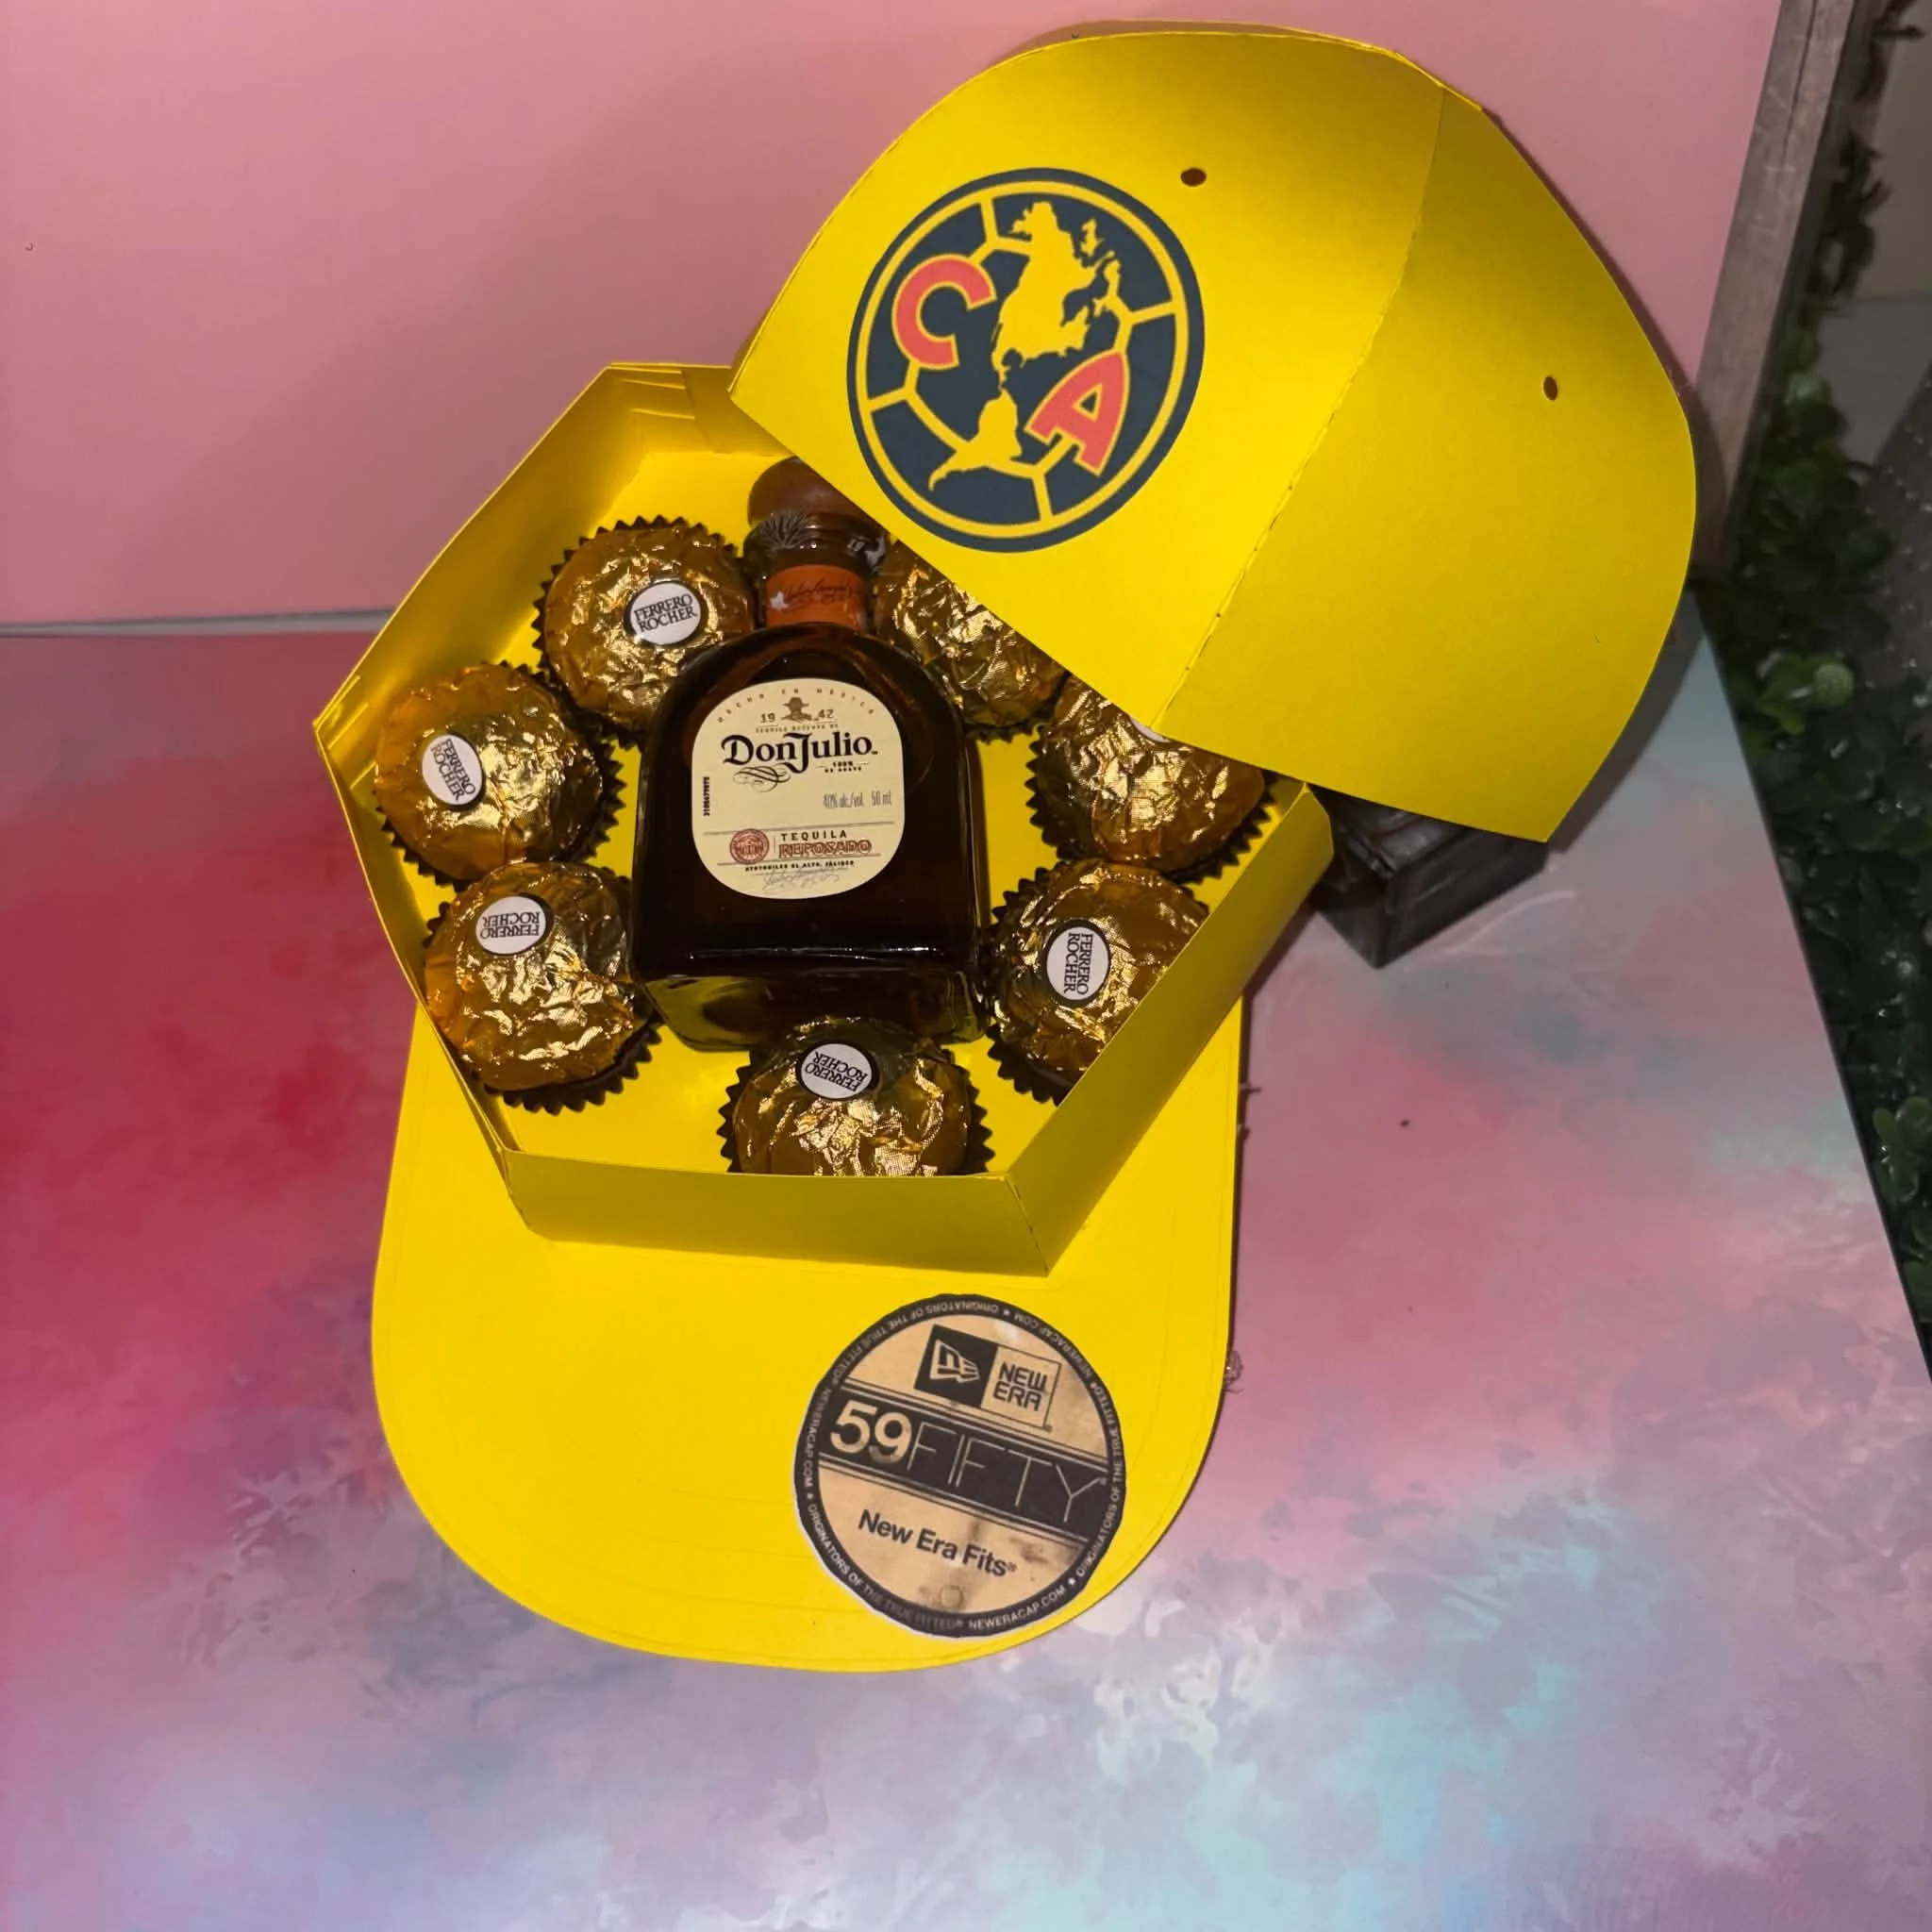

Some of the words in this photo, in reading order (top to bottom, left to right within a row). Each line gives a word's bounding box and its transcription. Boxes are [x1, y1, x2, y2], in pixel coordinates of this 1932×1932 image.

[892, 255, 996, 369] C
[1024, 351, 1128, 475] A
[634, 593, 692, 623] FERRERO
[639, 606, 697, 632] ROCHER
[759, 712, 776, 724] 19
[818, 708, 835, 720] 42
[431, 743, 466, 801] ROCHER
[442, 739, 476, 796] FERRERO
[779, 840, 872, 858] REPOSADO
[781, 830, 847, 841] TEQUILA
[479, 924, 540, 940] FERRERO
[482, 911, 541, 927] ROCHER
[1063, 932, 1079, 993] ROCHER
[1076, 933, 1093, 995] FERRERO
[805, 1062, 860, 1092] FERRERO
[814, 1051, 868, 1082] ROCHER
[998, 1361, 1047, 1391] NEW
[993, 1383, 1042, 1411] ERA
[1108, 1486, 1120, 1502] OF
[807, 1503, 851, 1575] ORIGINATORS
[846, 1570, 863, 1588] OF
[858, 1508, 913, 1544] New
[916, 1527, 958, 1559] Era
